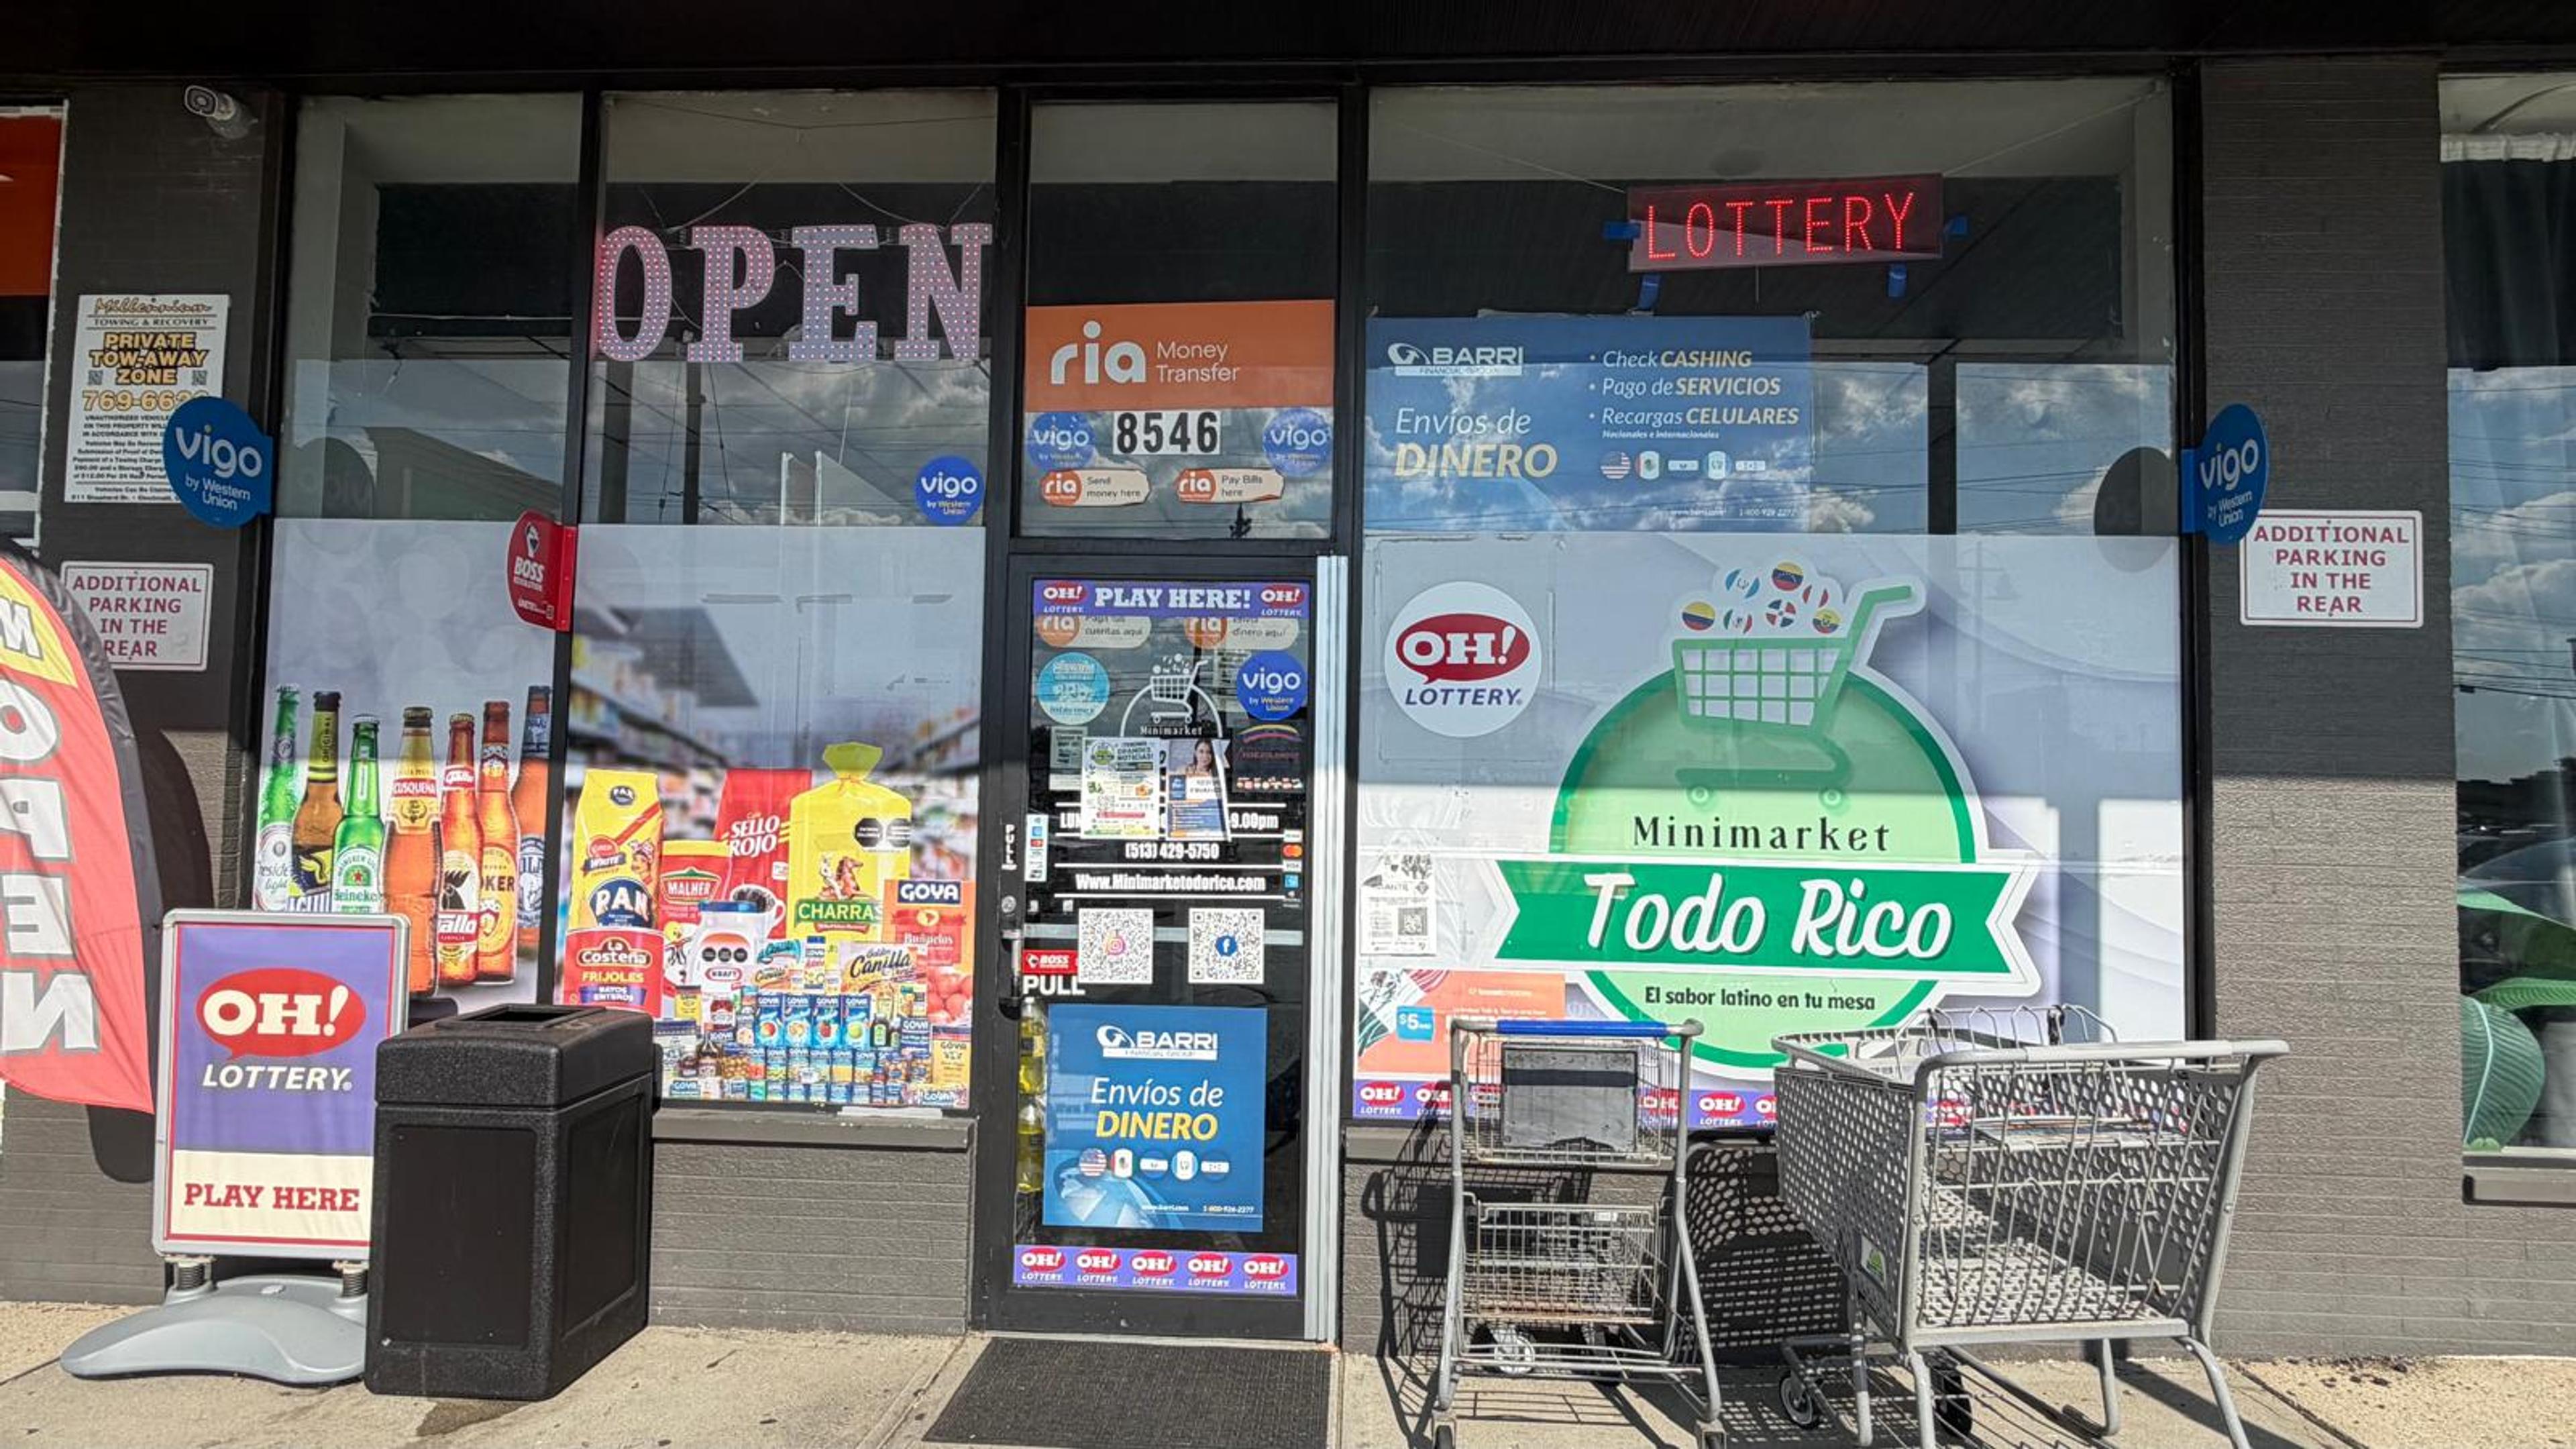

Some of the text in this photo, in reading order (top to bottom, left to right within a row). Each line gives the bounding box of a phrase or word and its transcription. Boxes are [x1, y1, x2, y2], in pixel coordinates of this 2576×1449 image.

[1649, 193, 1914, 260] LOTTERY
[596, 224, 993, 362] OPEN
[95, 317, 208, 327] TOWING & RECOVERY
[103, 331, 197, 350] PRIVATE
[89, 349, 210, 368] TOW-AWAY
[1051, 320, 1229, 385] ria Money
[1432, 346, 1525, 365] BARRI
[1603, 350, 1754, 368] Check CASHING
[115, 366, 178, 385] ZONE
[1155, 364, 1240, 383] Transfer
[1601, 377, 1781, 399] Pago de SERVICIOS
[1395, 407, 1531, 435] Envíos de
[1601, 407, 1800, 428] Recargas CELULARES
[1033, 424, 1089, 451] vigo
[1116, 412, 1218, 454] 8546
[1269, 422, 1328, 450] vigo
[1602, 429, 1648, 439] Nacionales
[1656, 429, 1719, 439] Internacionales
[175, 424, 263, 478] vigo
[1394, 442, 1558, 478] DINERO
[2200, 438, 2259, 491] vigo
[184, 473, 252, 501] by Western
[920, 471, 977, 498] vigo
[1045, 472, 1111, 494] ria Send
[1179, 472, 1263, 492] ria Pay Bills
[203, 490, 238, 511] Union
[1221, 489, 1243, 497] here
[2218, 490, 2253, 512] Western
[2218, 508, 2244, 528] Union
[2253, 525, 2410, 544] ADDITIONAL
[2275, 549, 2386, 568] PARKING
[513, 557, 545, 583] BOSS
[73, 576, 201, 593] ADDITIONAL
[2291, 572, 2371, 590] IN THE
[89, 598, 182, 614] PARKING
[1043, 586, 1301, 609] OH! PLAY HERE! OH!
[2297, 595, 2363, 613] REAR
[1260, 608, 1302, 616] LOTTERY
[100, 619, 168, 635] IN THE
[1232, 627, 1263, 637] dinero
[103, 640, 158, 657] REAR
[1402, 625, 1517, 667] OH!
[1242, 666, 1301, 695] vigo
[1405, 688, 1522, 706] LOTTERY
[1140, 724, 1203, 736] Minimarket
[730, 815, 780, 838] SELLO
[1633, 815, 1892, 853] Minimarket
[729, 834, 777, 859] ROJO
[1125, 843, 1220, 859] (513) 429-5750
[667, 881, 711, 896] MALHER
[900, 883, 959, 902] GOYA
[798, 902, 883, 920] CHARRAS
[1583, 871, 1955, 960] Todo Rico
[608, 941, 623, 951] La
[850, 950, 911, 978] Canilla
[1040, 955, 1070, 965] BOSS
[582, 971, 644, 983] FRIJOLES
[712, 970, 737, 978] KRAFT
[1023, 974, 1086, 996] PULL
[1645, 986, 1876, 1011] El sabor latino en tu mesa
[203, 985, 350, 1037] OH!
[1136, 1030, 1218, 1050] BARRI
[203, 1063, 352, 1091] LOTTERY
[1090, 1077, 1224, 1108] Envíos de
[1360, 1085, 1401, 1102] OH!
[1699, 1097, 1741, 1112] OH!
[1095, 1110, 1218, 1140] DINERO
[184, 1183, 360, 1212] PLAY HERE
[1021, 1251, 1062, 1267] OH!
[1076, 1254, 1117, 1269] OH!
[1131, 1256, 1173, 1272] OH!
[1187, 1257, 1228, 1273] OH!
[1242, 1258, 1285, 1275] OH!
